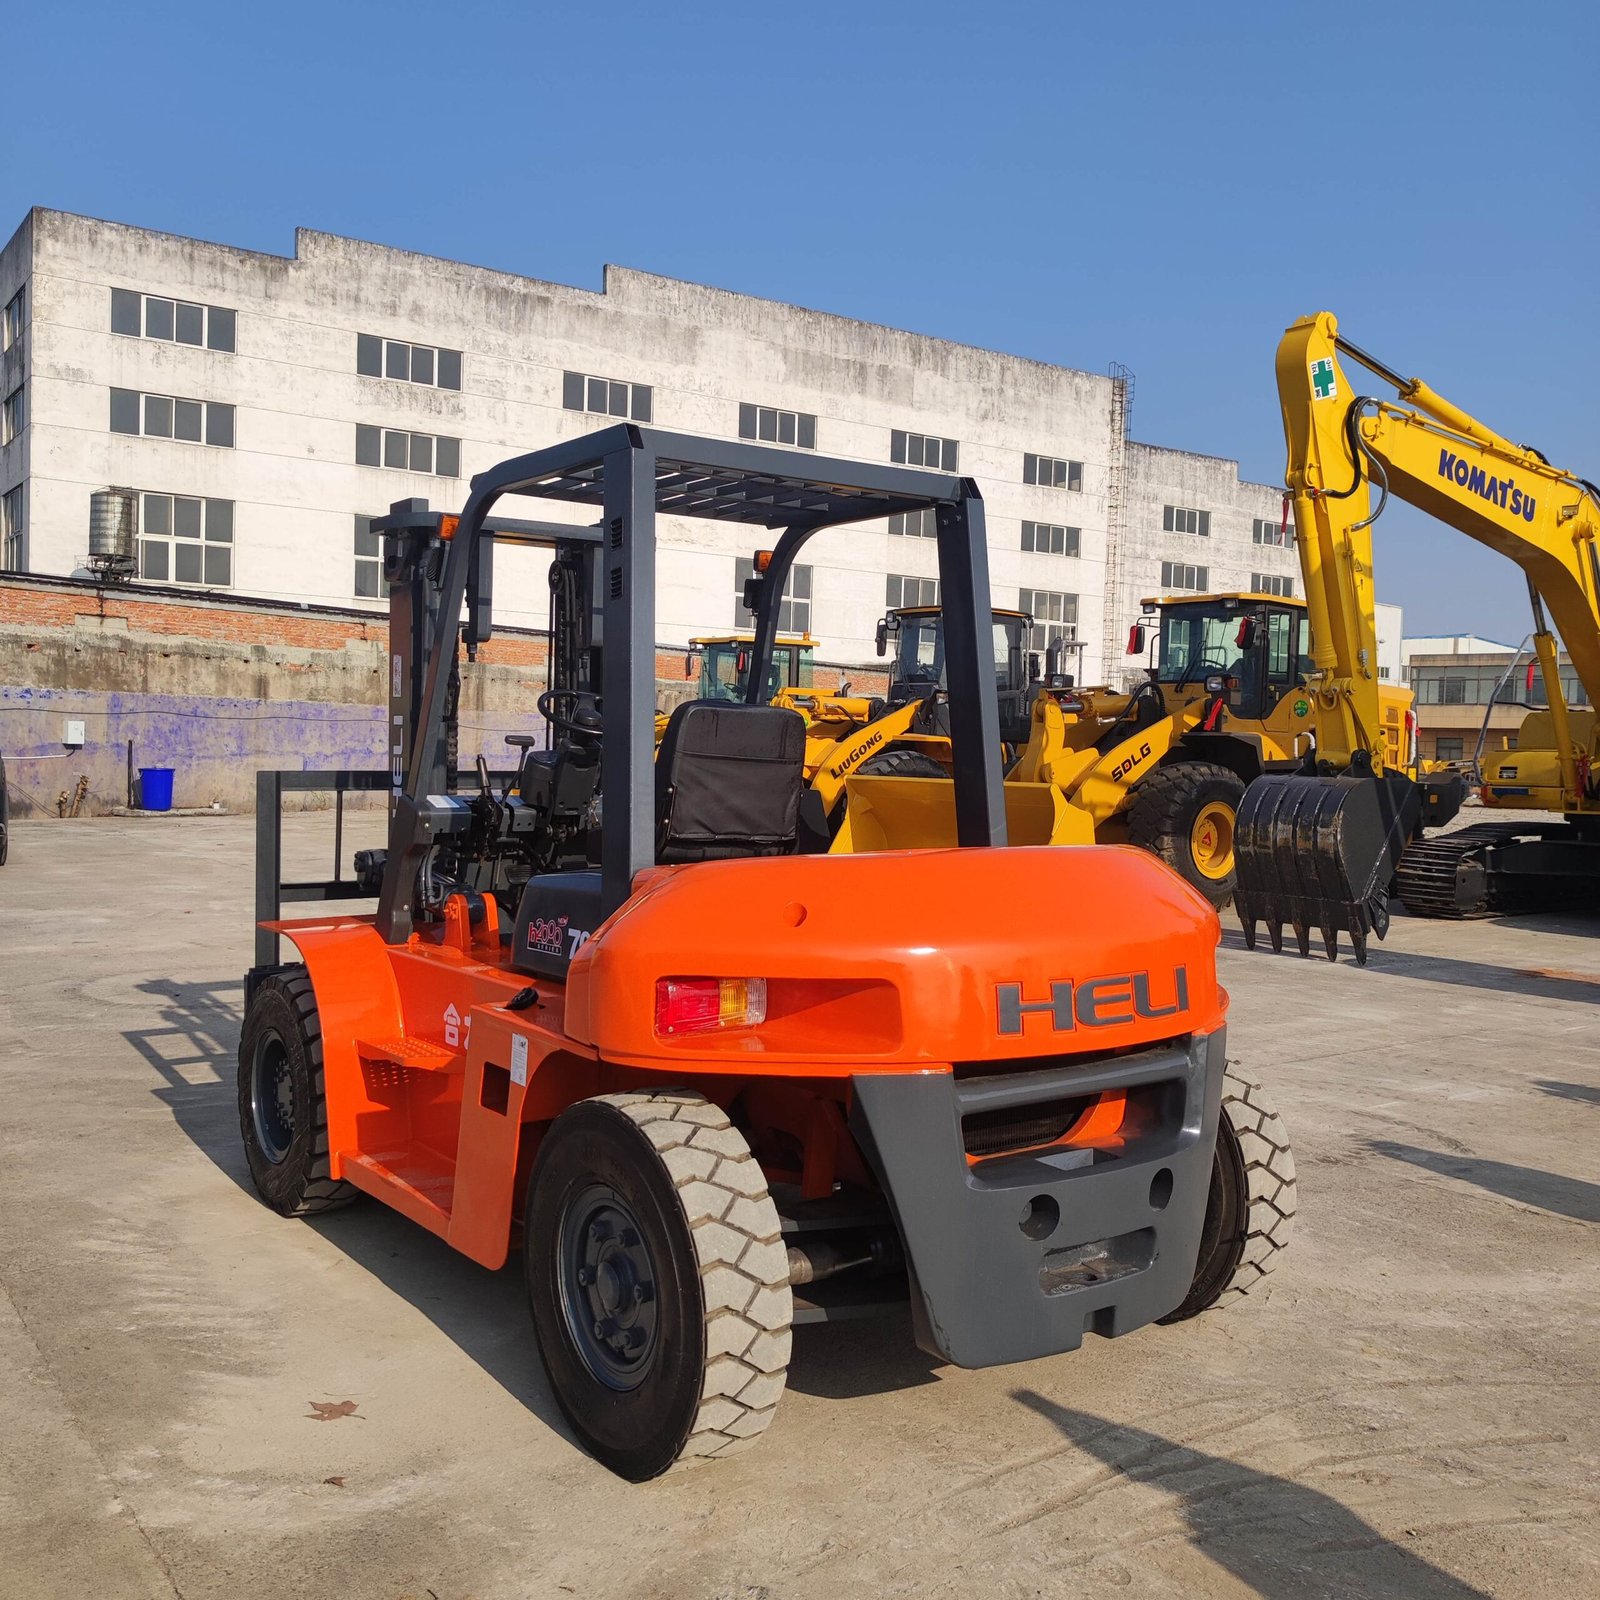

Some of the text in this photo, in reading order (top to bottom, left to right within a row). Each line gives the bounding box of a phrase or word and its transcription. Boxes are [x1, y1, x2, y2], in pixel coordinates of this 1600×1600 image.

[1438, 448, 1536, 522] KOMATSU
[1111, 742, 1151, 783] SDLG
[997, 966, 1190, 1034] HELI
